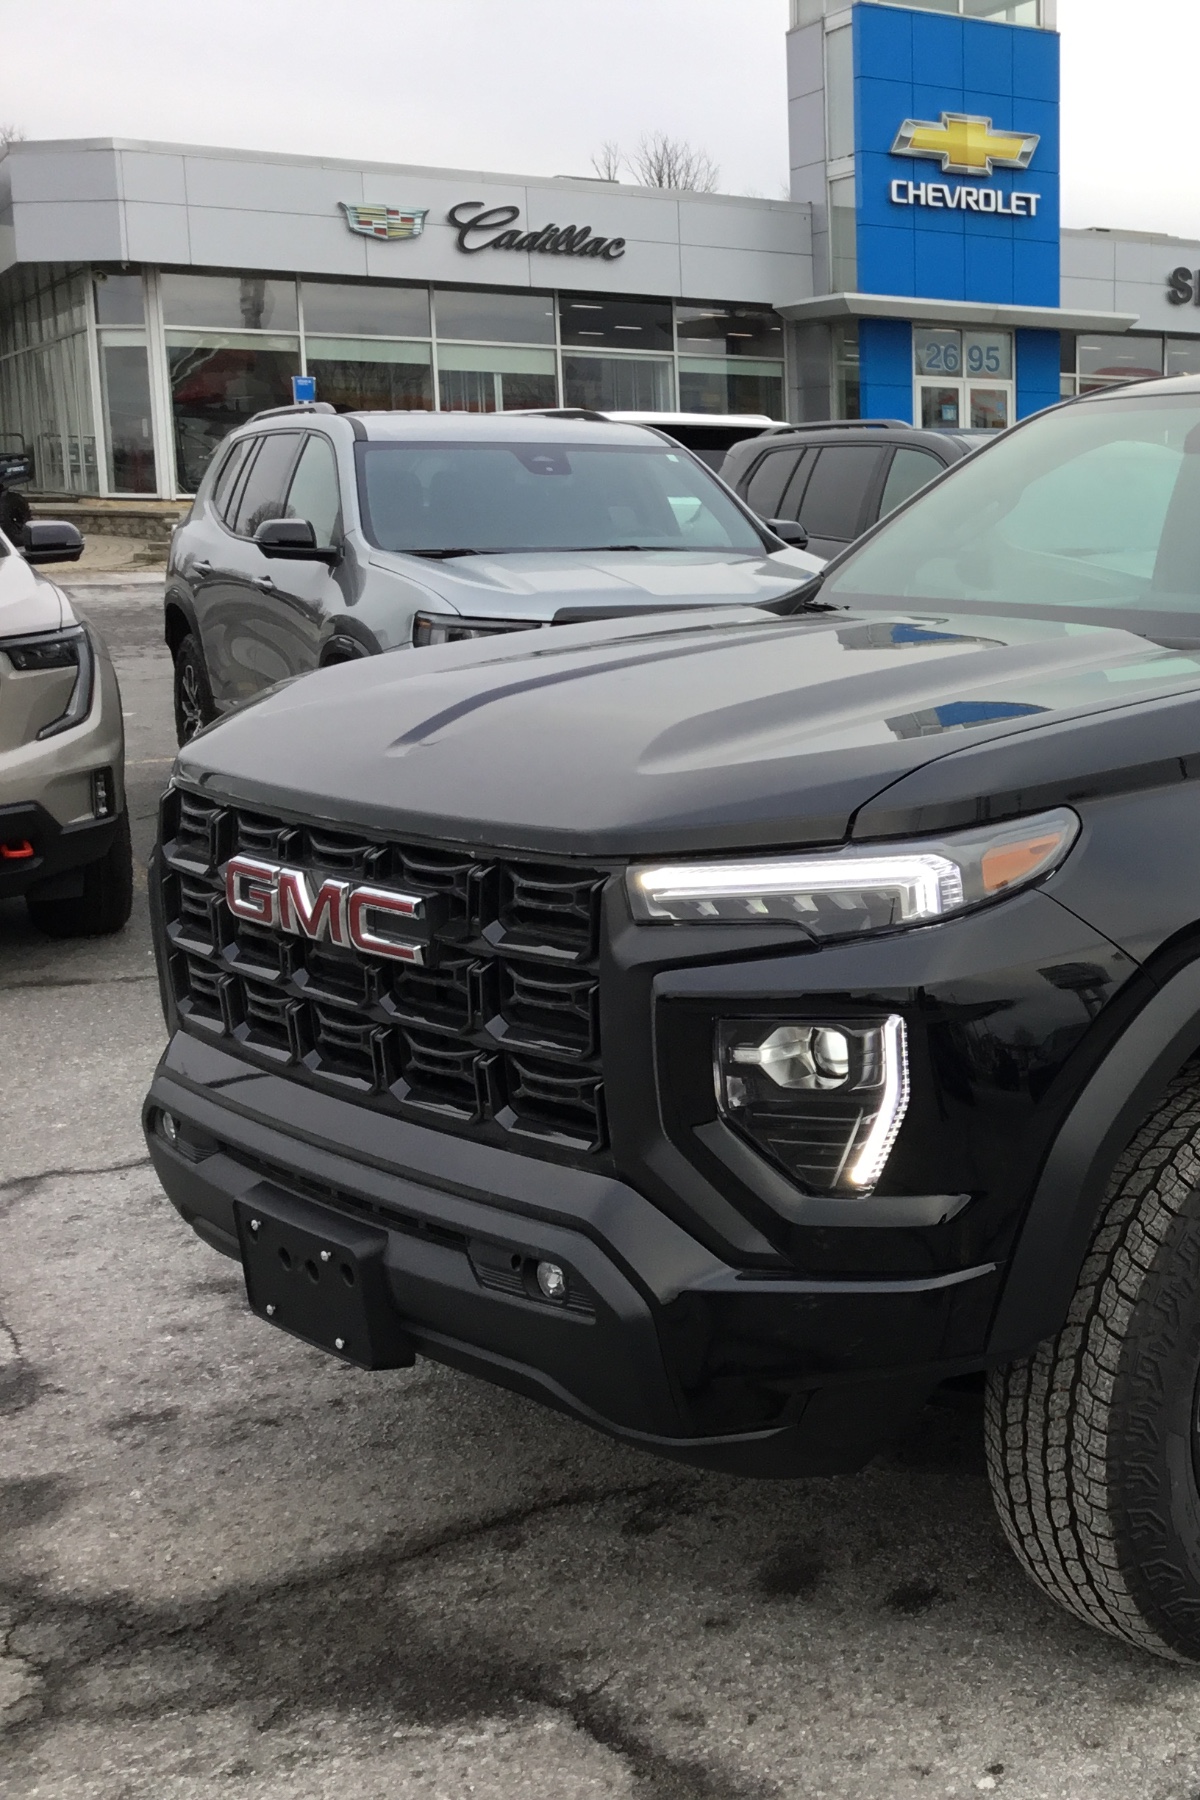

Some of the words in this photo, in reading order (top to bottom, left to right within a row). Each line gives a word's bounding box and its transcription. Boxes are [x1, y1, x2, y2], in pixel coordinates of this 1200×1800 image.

[890, 179, 1041, 216] CHEVROLET
[446, 201, 626, 260] Cadillac
[225, 856, 426, 965] GMC
